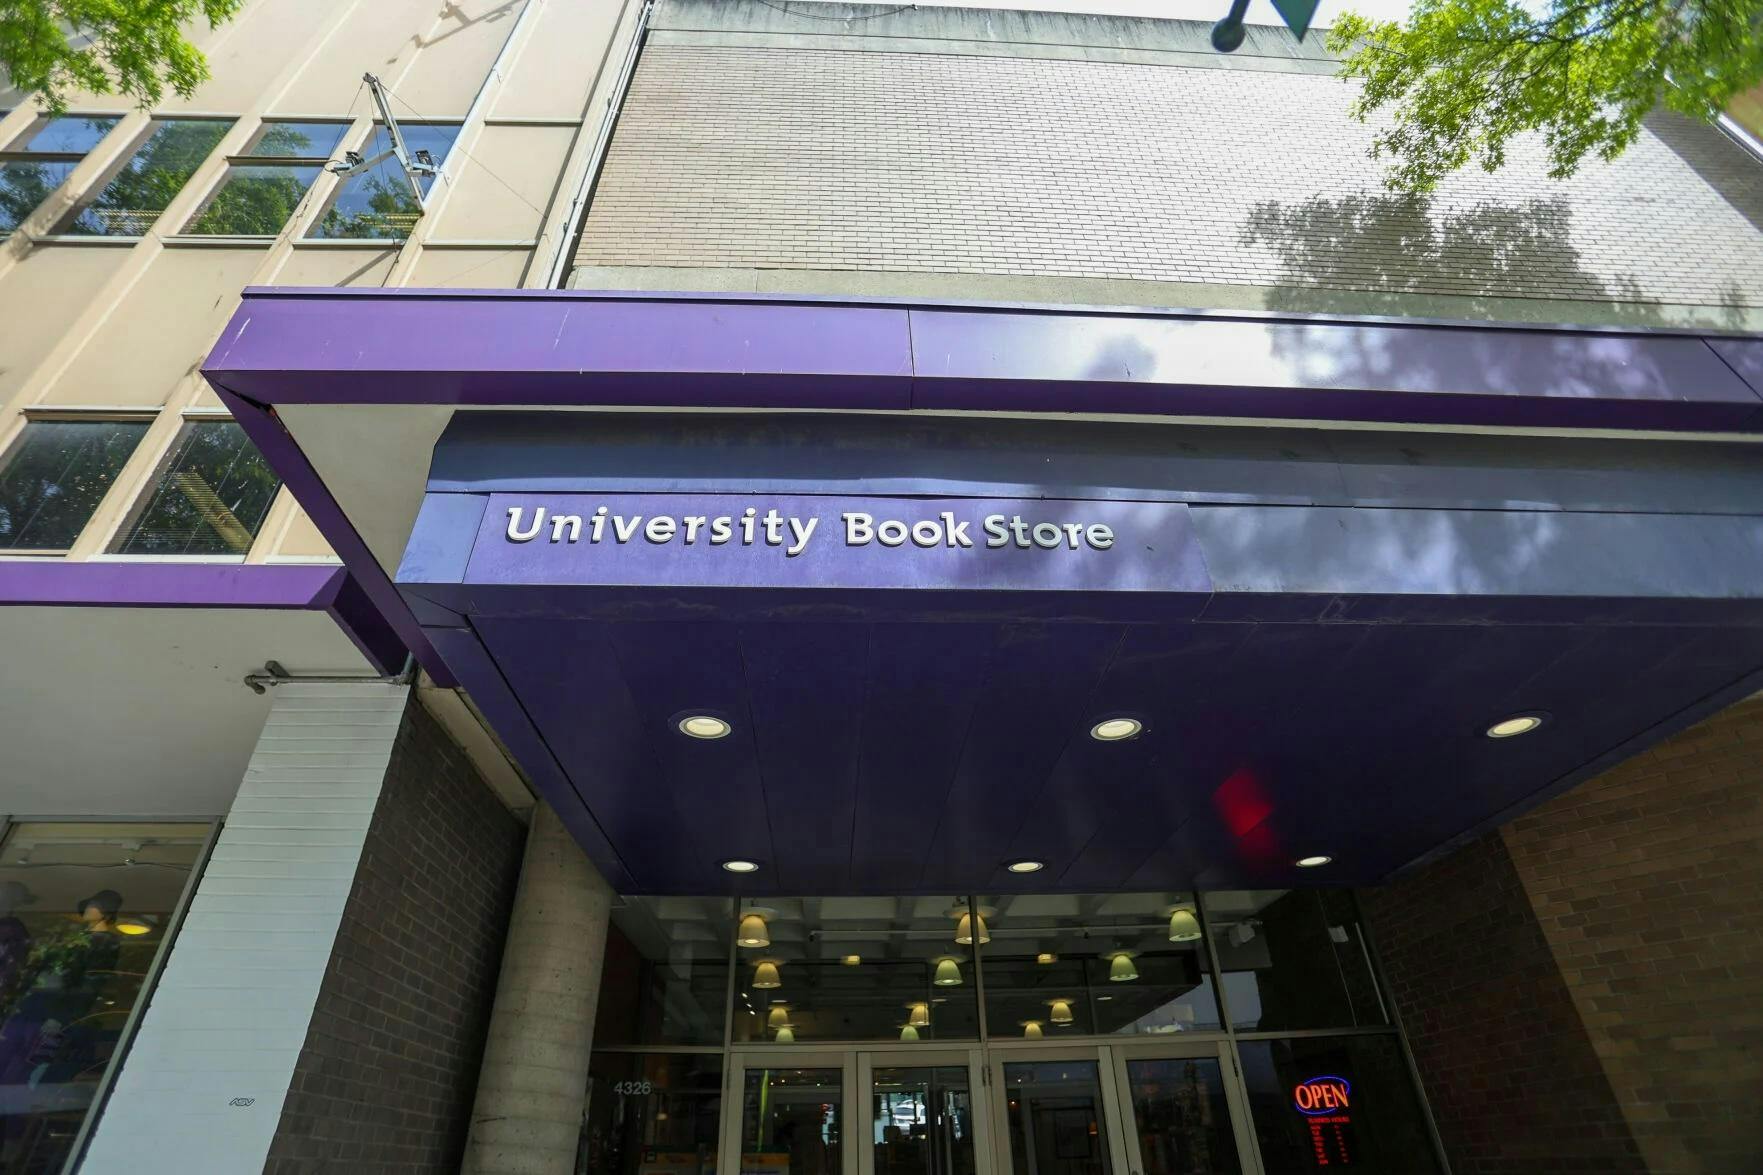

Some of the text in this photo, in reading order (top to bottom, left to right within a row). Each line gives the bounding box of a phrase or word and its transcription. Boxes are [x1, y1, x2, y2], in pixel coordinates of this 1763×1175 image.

[505, 506, 1115, 557] University Book Store
[613, 1081, 652, 1096] 4326
[1295, 1083, 1349, 1109] OPEN
